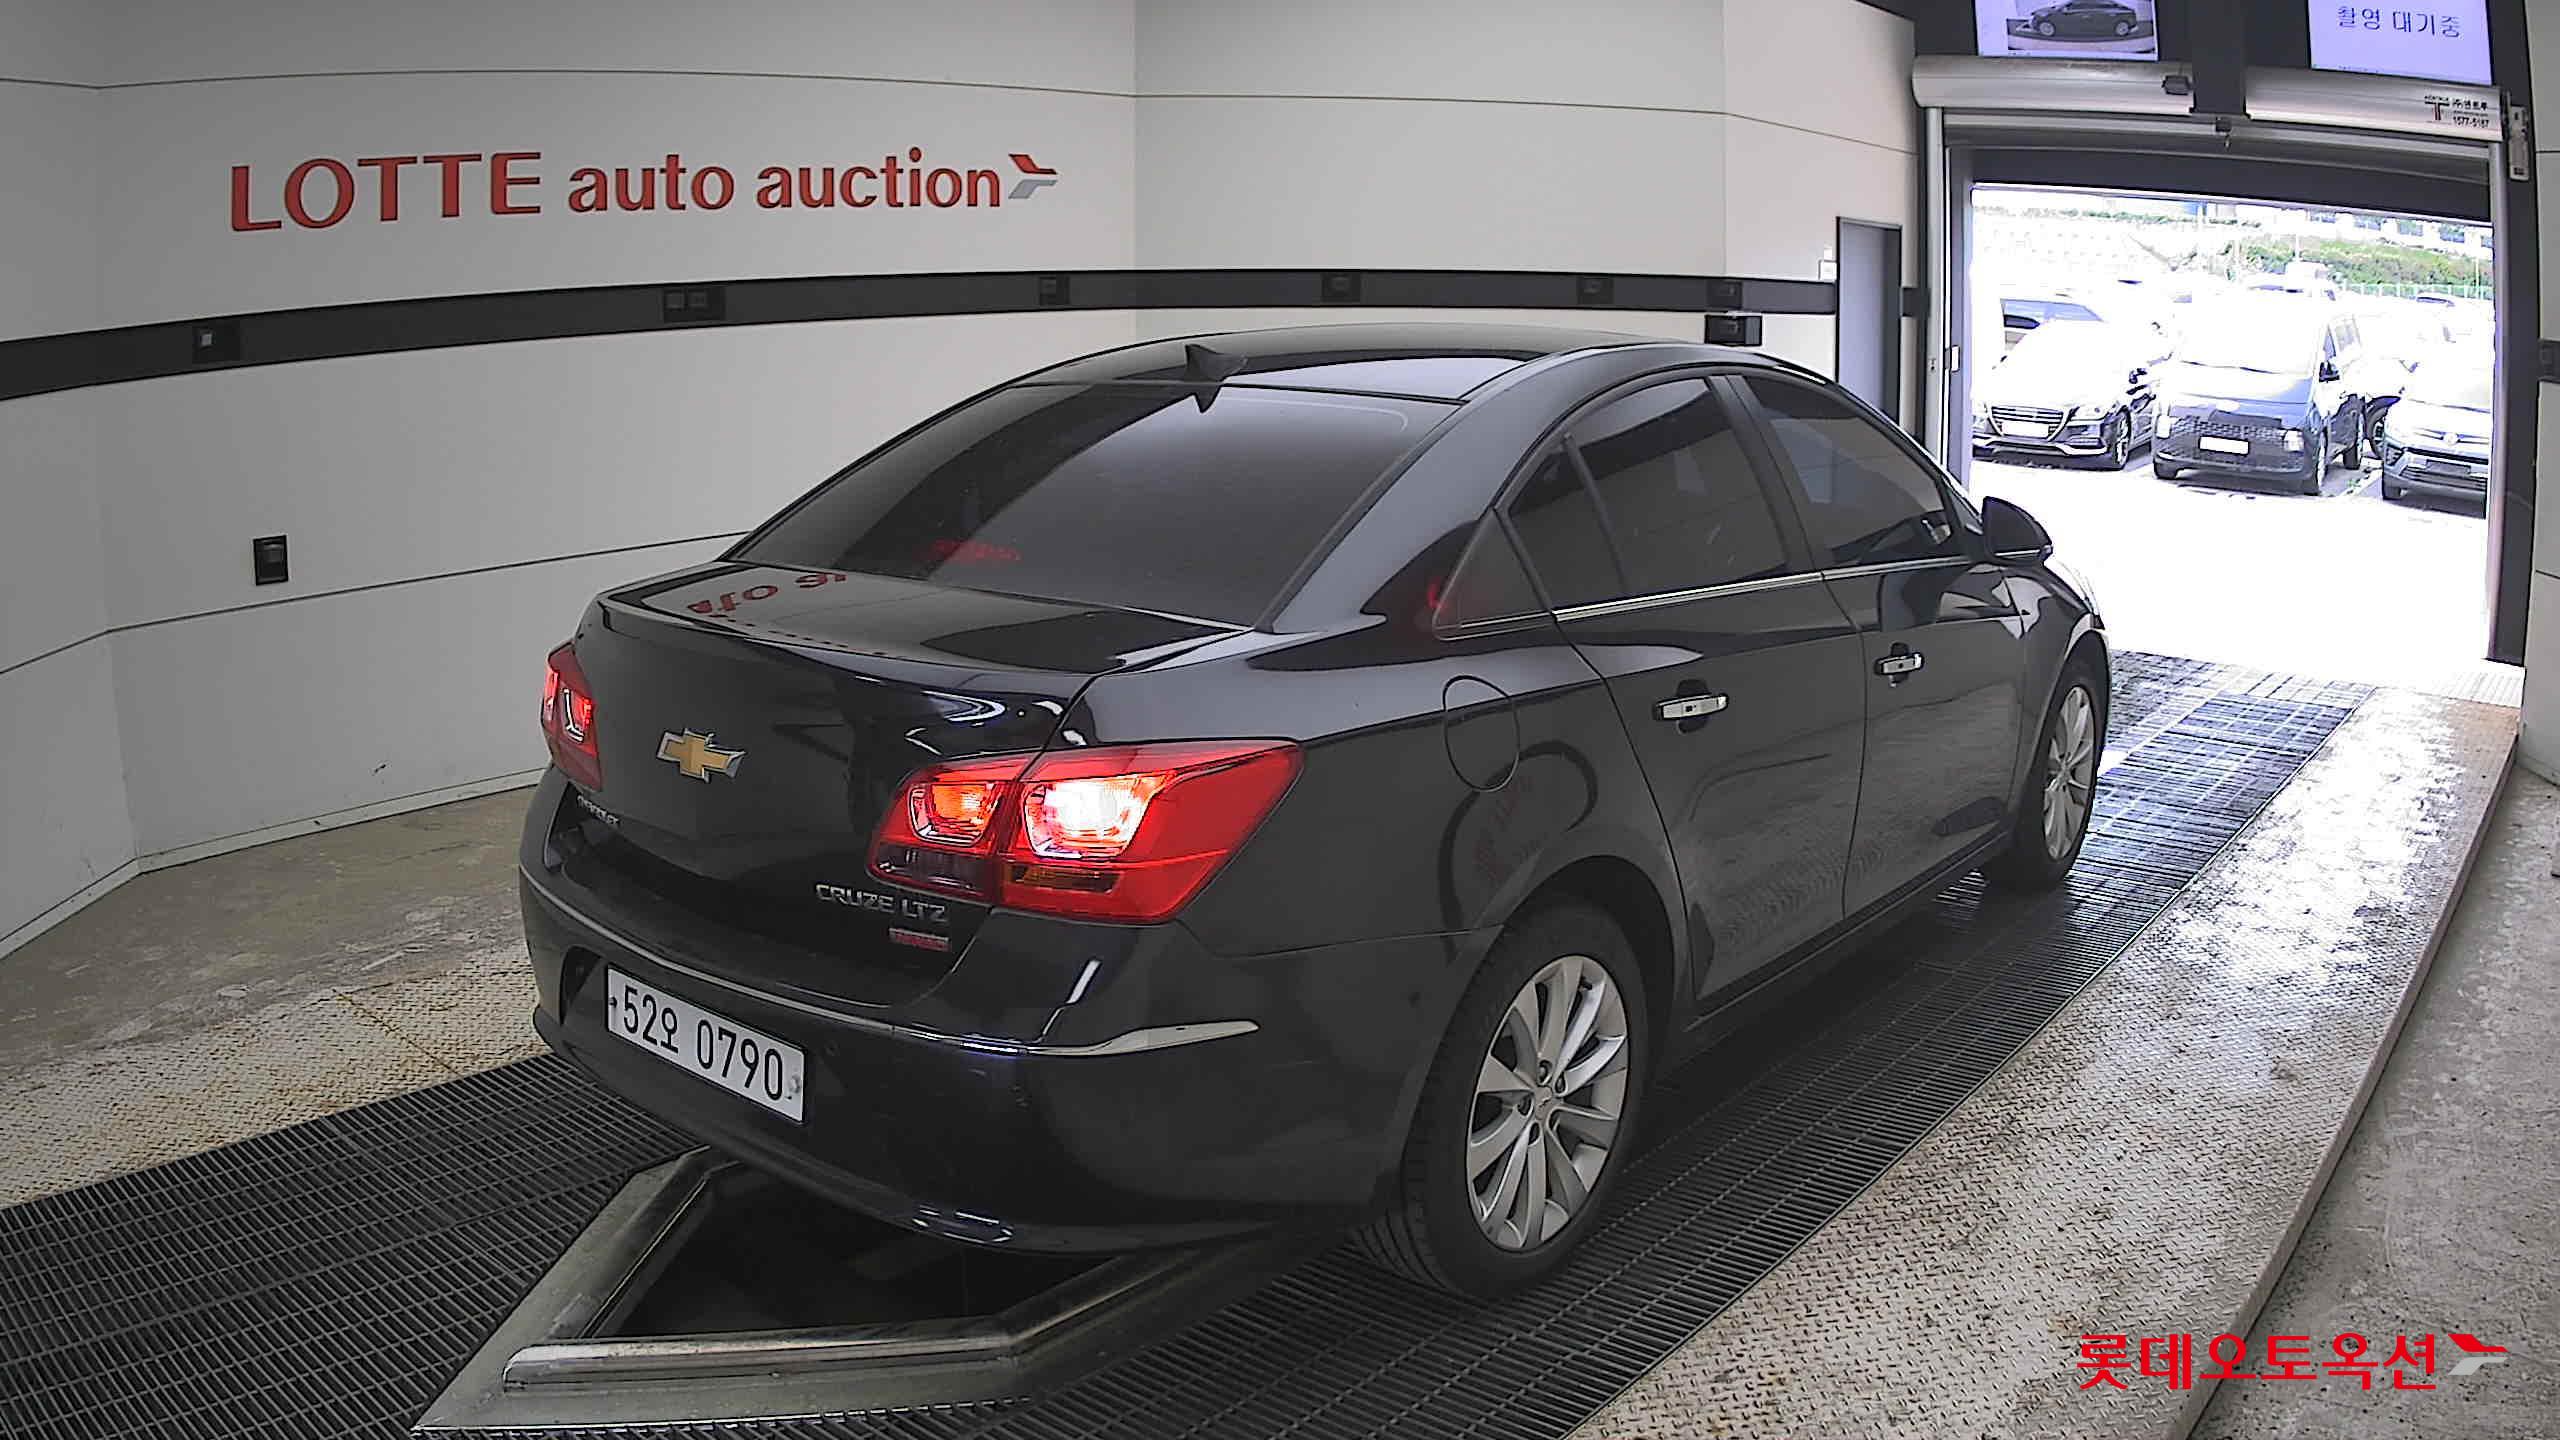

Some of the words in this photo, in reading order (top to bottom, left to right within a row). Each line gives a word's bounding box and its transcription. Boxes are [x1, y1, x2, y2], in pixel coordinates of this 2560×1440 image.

[2338, 6, 2381, 31] 촬영
[2392, 11, 2460, 38] 대기중
[231, 152, 541, 231] LOTTE
[568, 153, 735, 213] auto
[756, 147, 1000, 208] auction
[815, 884, 896, 914] CRUZE
[902, 899, 948, 922] LTZ
[623, 985, 679, 1054] 52오
[696, 1019, 783, 1101] 0790
